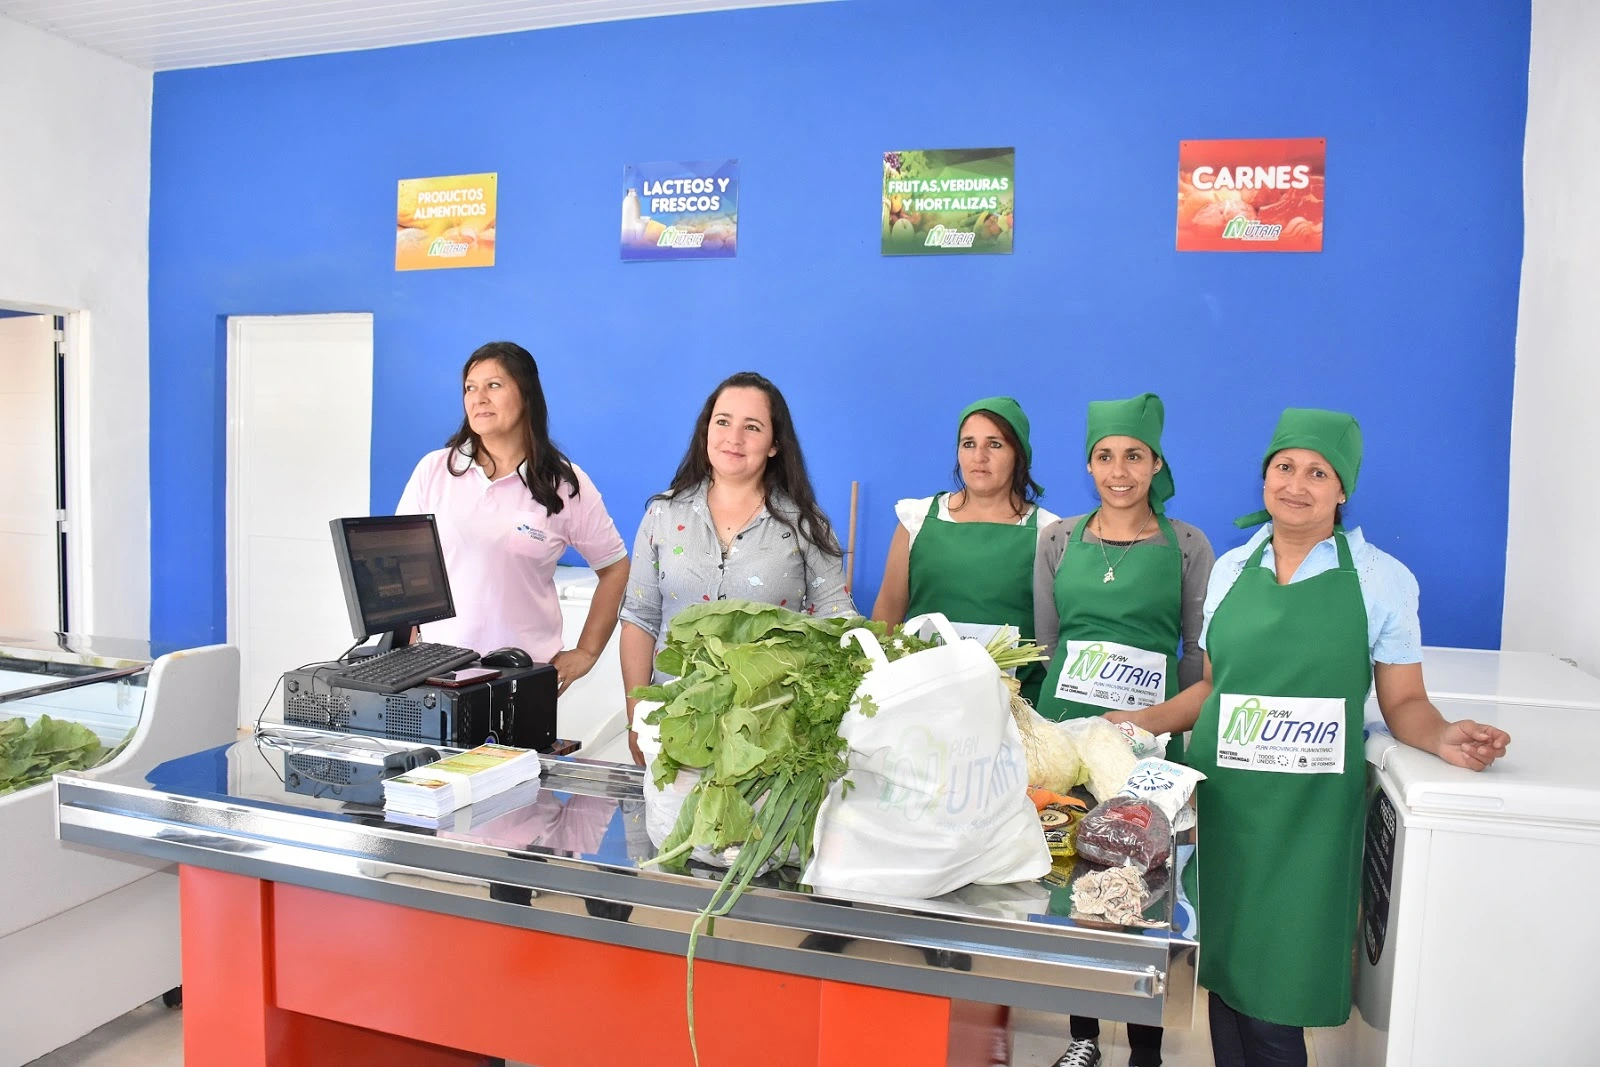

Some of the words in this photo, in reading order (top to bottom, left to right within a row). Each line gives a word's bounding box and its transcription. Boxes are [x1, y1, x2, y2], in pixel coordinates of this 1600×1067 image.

[1192, 165, 1310, 190] CARNES
[643, 178, 714, 196] LACTEOS
[717, 177, 730, 193] Y
[417, 188, 484, 204] PRODUCTOS
[651, 195, 720, 213] FRESCOS
[902, 199, 913, 211] Y
[915, 196, 997, 211] HORTALIZAS
[414, 203, 487, 220] ALIMENTICIOS
[1107, 653, 1129, 662] PLAN
[1069, 651, 1162, 690] NUTRIR
[1267, 709, 1292, 718] PLAN
[1225, 707, 1339, 746] NUTRIR
